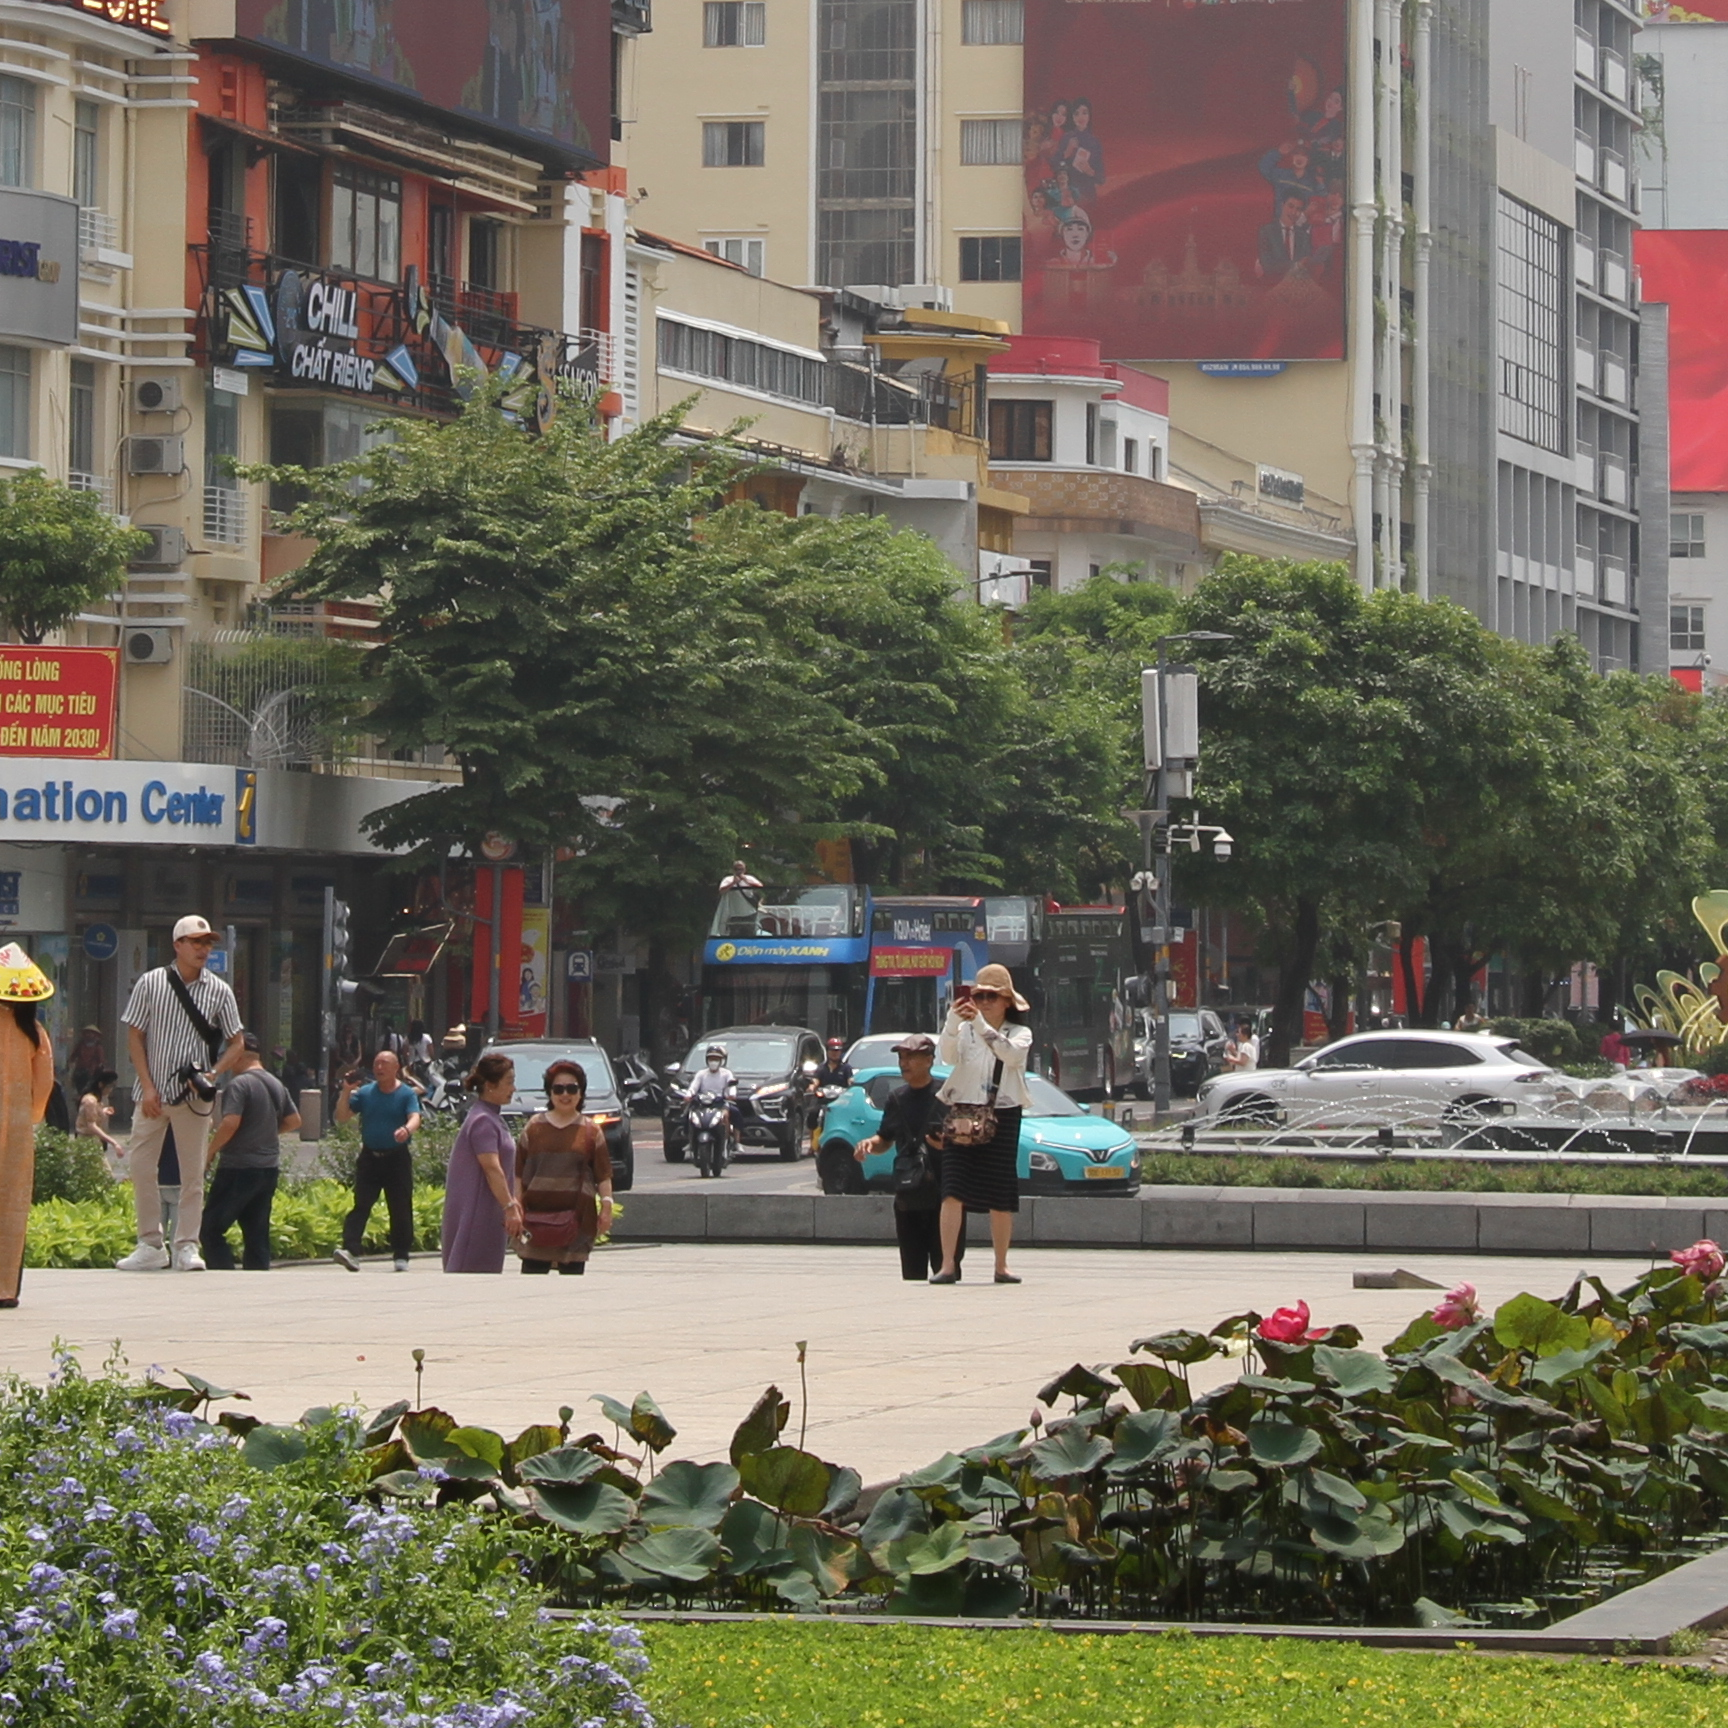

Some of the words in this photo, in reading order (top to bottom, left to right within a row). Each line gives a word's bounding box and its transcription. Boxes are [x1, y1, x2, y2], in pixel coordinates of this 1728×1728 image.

[307, 283, 358, 339] CHILL
[291, 337, 333, 381] CHẤT
[334, 348, 374, 391] RIÊNG
[25, 656, 60, 681] LÒNG
[5, 689, 31, 714] CÁC
[35, 692, 64, 718] MỤC
[68, 690, 96, 715] TIÊU
[0, 721, 27, 747] ĐẾN
[30, 724, 61, 748] NĂM
[64, 728, 101, 749] 2030!
[141, 780, 226, 826] Center
[789, 946, 829, 957] XANH
